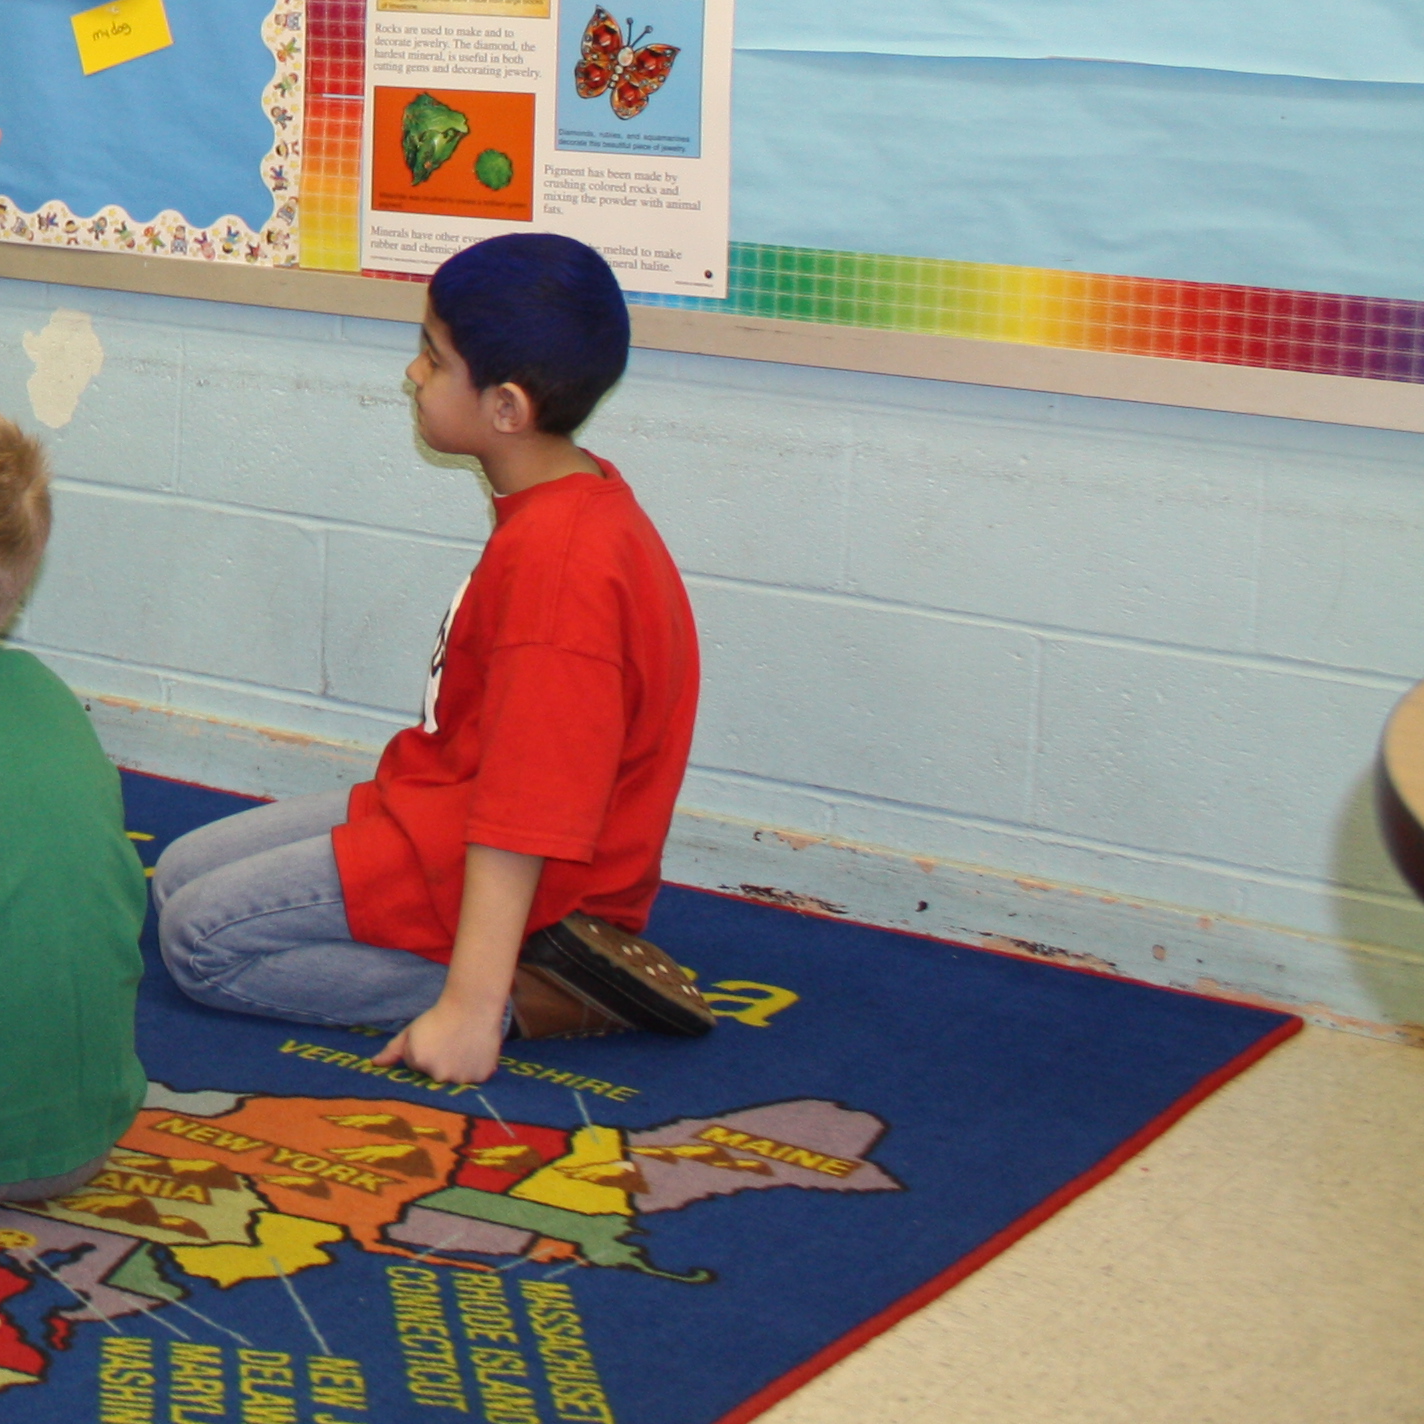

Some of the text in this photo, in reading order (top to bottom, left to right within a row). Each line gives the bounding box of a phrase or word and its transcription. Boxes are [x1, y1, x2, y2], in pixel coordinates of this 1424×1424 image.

[154, 1117, 393, 1192] NEW YORK
[697, 1126, 855, 1176] MAINE
[385, 1265, 470, 1413] CONNECTICUT
[451, 1271, 543, 1424] RHODE ISLAND
